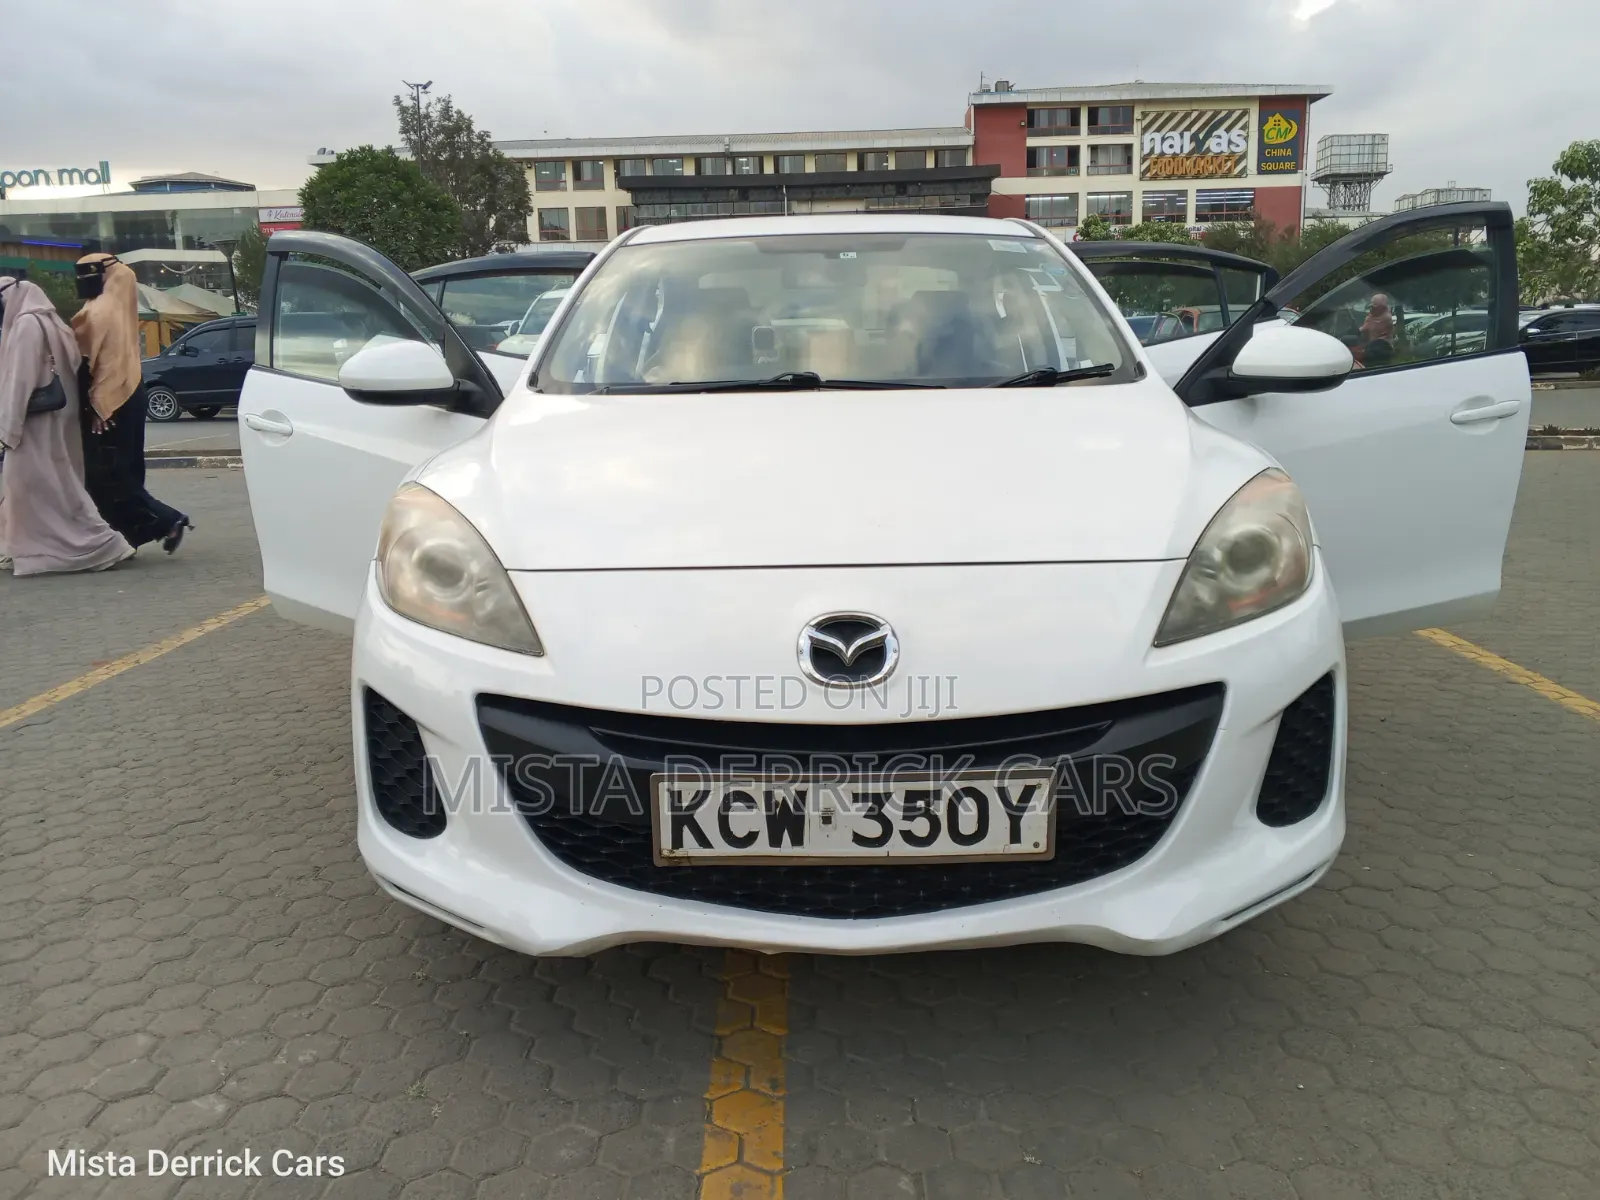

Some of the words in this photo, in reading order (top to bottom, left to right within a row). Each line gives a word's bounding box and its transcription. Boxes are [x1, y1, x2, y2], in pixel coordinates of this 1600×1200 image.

[1265, 126, 1289, 141] CM
[1265, 148, 1292, 157] CHINA
[57, 160, 111, 186] mall
[1150, 155, 1236, 176] FOODMARKET
[1261, 162, 1296, 171] SQUARE
[669, 789, 808, 851] KCW
[851, 784, 1041, 849] 350Y
